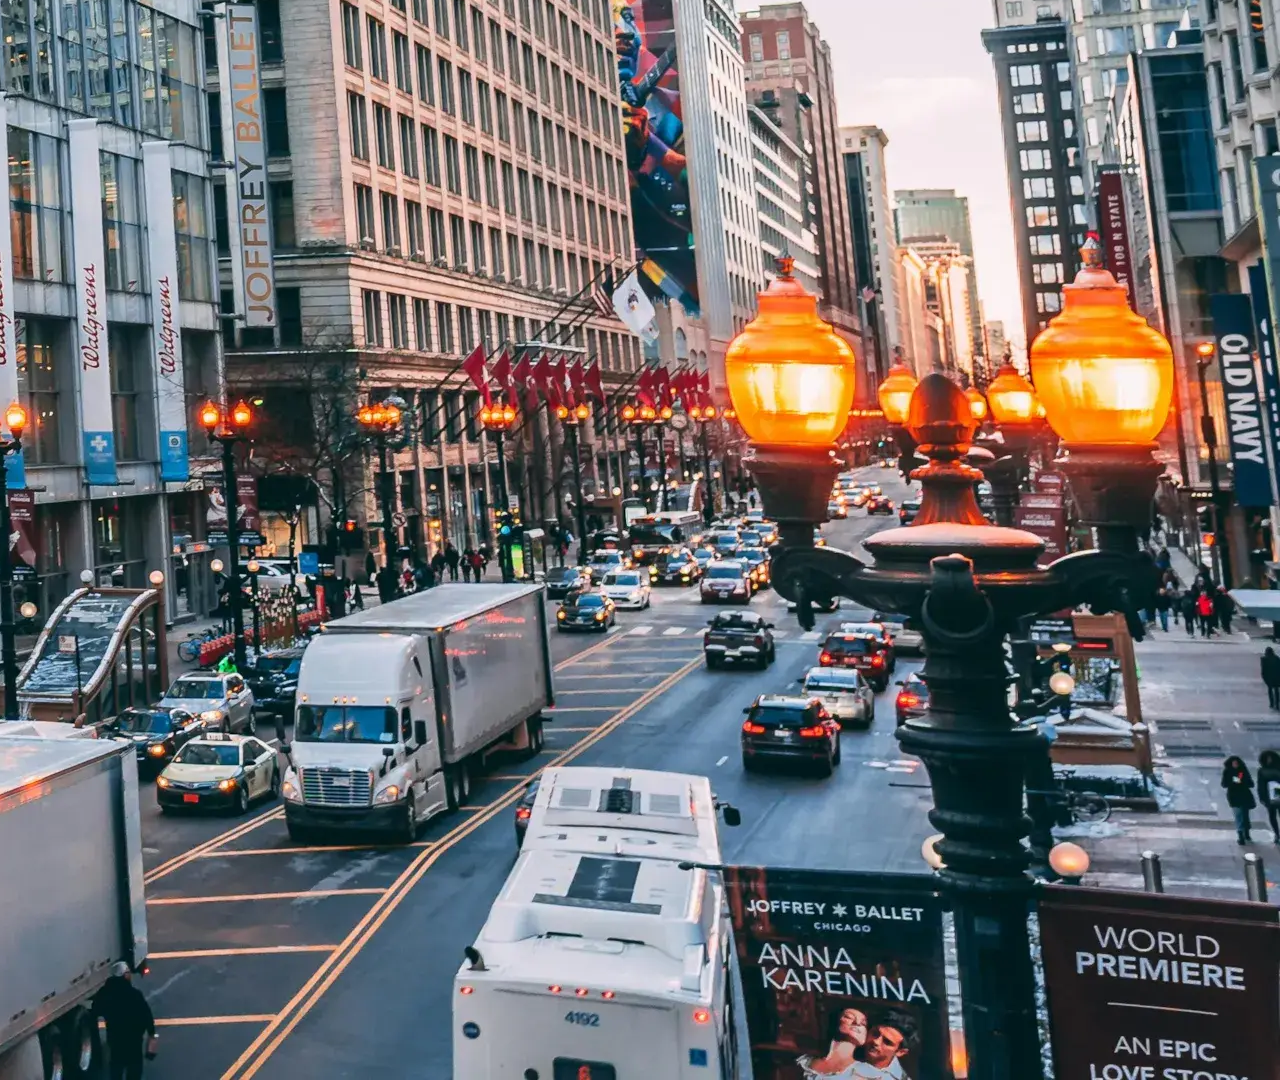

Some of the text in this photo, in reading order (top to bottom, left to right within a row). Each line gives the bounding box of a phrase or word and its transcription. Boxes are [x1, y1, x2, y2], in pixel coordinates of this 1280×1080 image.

[230, 9, 273, 322] JOFFREY BALLET
[1108, 195, 1121, 228] STATE
[81, 263, 104, 371] Walgreens
[161, 276, 179, 377] Walgreens
[1220, 333, 1264, 464] OLD NAVY
[747, 899, 924, 921] JOFFREY BALLET
[814, 922, 871, 933] CHICAGO
[1093, 924, 1220, 959] WORLD
[758, 943, 857, 970] ANNA
[1076, 951, 1246, 991] PREMIERE
[761, 967, 931, 1004] KARENINA
[564, 1011, 600, 1027] 4192
[1114, 1036, 1217, 1062] AN EPIC
[1090, 1063, 1155, 1080] LOVE
